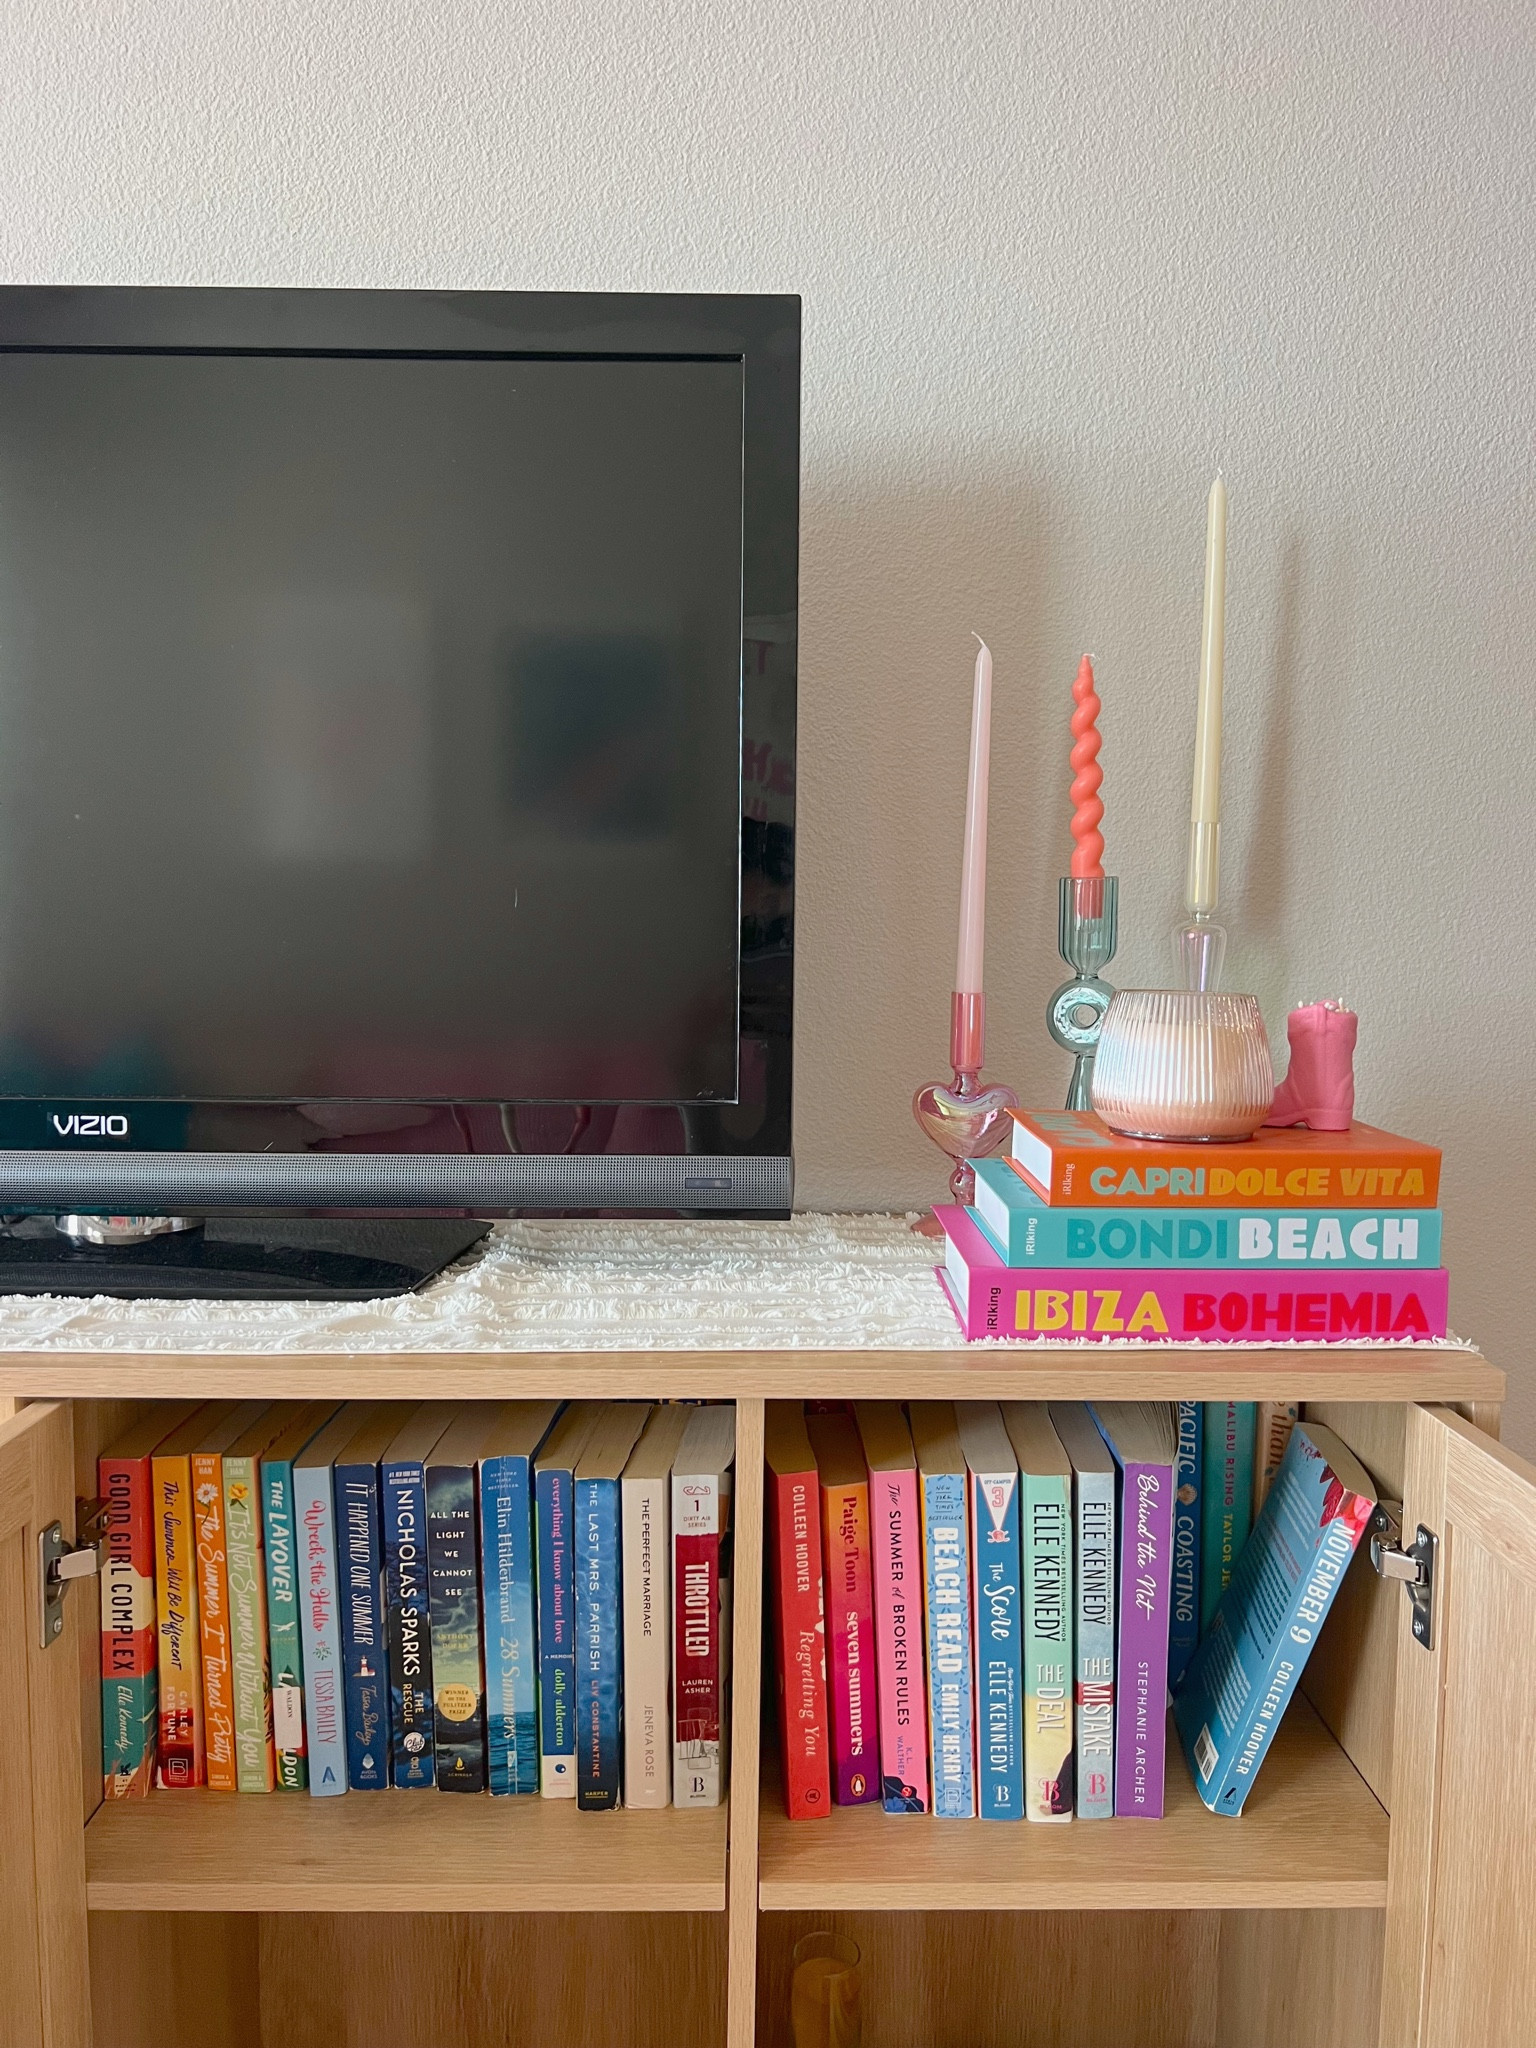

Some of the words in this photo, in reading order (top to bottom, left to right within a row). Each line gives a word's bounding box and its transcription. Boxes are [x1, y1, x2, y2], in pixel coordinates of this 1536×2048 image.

[53, 1115, 128, 1135] VIZIO
[1090, 1166, 1205, 1196] CAPRI
[1209, 1167, 1329, 1197] DOLCE
[1340, 1167, 1425, 1197] VITA
[1067, 1218, 1228, 1260] BONDI
[1238, 1218, 1419, 1260] BEACH
[1014, 1289, 1169, 1333] IBIZA
[1182, 1291, 1431, 1333] BOHEMIA
[1226, 1401, 1236, 1451] MALIBU
[1269, 1413, 1292, 1472] than
[109, 1473, 131, 1523] GOOD
[163, 1481, 179, 1506] This
[271, 1481, 284, 1508] THE
[346, 1483, 370, 1497] IT
[589, 1483, 598, 1506] THE
[887, 1483, 901, 1506] The
[992, 1486, 1004, 1508] 3
[1224, 1458, 1235, 1506] RISING
[195, 1505, 221, 1541] The
[227, 1502, 252, 1540] It's
[497, 1496, 512, 1528] Elin
[551, 1478, 564, 1538] everything
[694, 1500, 699, 1512] 1
[792, 1485, 807, 1540] COLLEEN
[838, 1496, 859, 1545] Paige
[1033, 1503, 1060, 1546] ELLE
[1083, 1502, 1107, 1540] ELLE
[1136, 1474, 1160, 1538] Behind
[163, 1511, 181, 1562] Summer
[303, 1501, 328, 1560] Wreck
[347, 1502, 370, 1562] HAPPENED
[397, 1489, 417, 1598] NICHOLAS
[588, 1513, 599, 1551] LAST
[642, 1522, 650, 1574] PERFECT
[889, 1510, 903, 1581] SUMMER
[1222, 1513, 1233, 1563] TAYLOR
[110, 1533, 132, 1576] GIRL
[229, 1542, 251, 1570] Not
[269, 1512, 292, 1603] LAYOVER
[309, 1561, 330, 1585] the
[351, 1565, 371, 1589] ONE
[433, 1569, 473, 1577] CANNOT
[553, 1550, 564, 1580] know
[589, 1558, 600, 1596] MRS.
[795, 1544, 809, 1592] HOOVER
[843, 1547, 859, 1592] Toon
[933, 1527, 960, 1605] BEACH
[989, 1562, 1004, 1582] The
[1137, 1542, 1153, 1568] the
[1175, 1516, 1195, 1623] COASTING
[1297, 1522, 1356, 1623] NOVEMBER
[167, 1568, 182, 1589] Will
[167, 1595, 182, 1607] Be
[199, 1544, 224, 1618] Summer
[497, 1533, 515, 1623] Hilderbrand
[554, 1584, 564, 1616] about
[1033, 1555, 1060, 1642] KENNEDY
[1082, 1547, 1107, 1625] KENNEDY
[1135, 1575, 1156, 1620] Net
[111, 1584, 134, 1671] COMPLEX
[230, 1572, 257, 1649] Summer
[309, 1586, 329, 1632] Halls
[351, 1593, 374, 1645] SUMMER
[642, 1577, 652, 1637] MARRIAGE
[685, 1561, 710, 1657] THROTTLED
[983, 1583, 1015, 1641] Score
[204, 1621, 225, 1645] I
[400, 1607, 420, 1677] SPARKS
[500, 1636, 519, 1661] 28
[554, 1620, 565, 1643] love
[589, 1603, 601, 1671] PARRISH
[846, 1611, 861, 1665] seven
[893, 1604, 907, 1671] BROKEN
[936, 1613, 962, 1673] READ
[1289, 1625, 1312, 1644] 9
[204, 1647, 226, 1710] Turned
[235, 1652, 260, 1728] Without
[314, 1668, 335, 1702] TESSA
[554, 1668, 565, 1696] dolly
[591, 1680, 600, 1697] LIV
[682, 1679, 713, 1687] LAUREN
[796, 1630, 817, 1719] Regretting
[988, 1661, 1006, 1696] ELLE
[1036, 1664, 1064, 1683] THE
[1083, 1658, 1111, 1676] THE
[1259, 1660, 1294, 1720] COLLEEN
[117, 1685, 133, 1705] Elle
[167, 1686, 177, 1741] FORTUNE
[179, 1690, 188, 1736] CARLEY
[285, 1690, 294, 1718] WALDON
[360, 1685, 377, 1711] Tessa
[402, 1683, 415, 1724] RESCUE
[414, 1692, 424, 1713] THE
[502, 1666, 520, 1739] Summers
[848, 1668, 865, 1756] summers
[895, 1677, 910, 1726] RULES
[941, 1683, 959, 1731] EMILY
[1036, 1687, 1065, 1734] DEAL
[1136, 1662, 1149, 1741] STEPHANIE
[117, 1707, 133, 1753] Kennedy
[208, 1711, 232, 1763] Pretty
[316, 1705, 337, 1744] BAILEY
[355, 1711, 378, 1746] Bailey
[555, 1699, 565, 1746] alderton
[591, 1701, 601, 1778] CONSTANTINE
[644, 1705, 655, 1746] JENEVA
[804, 1725, 819, 1756] You
[989, 1703, 1008, 1773] KENNEDY
[1082, 1681, 1111, 1756] MISTAKE
[234, 1727, 263, 1767] You
[645, 1749, 655, 1778] ROSE
[896, 1735, 905, 1776] WALTHER
[905, 1747, 912, 1755] K.
[943, 1734, 961, 1783] HENRY
[1236, 1722, 1268, 1775] HOOVER
[1134, 1747, 1146, 1803] ARCHER
